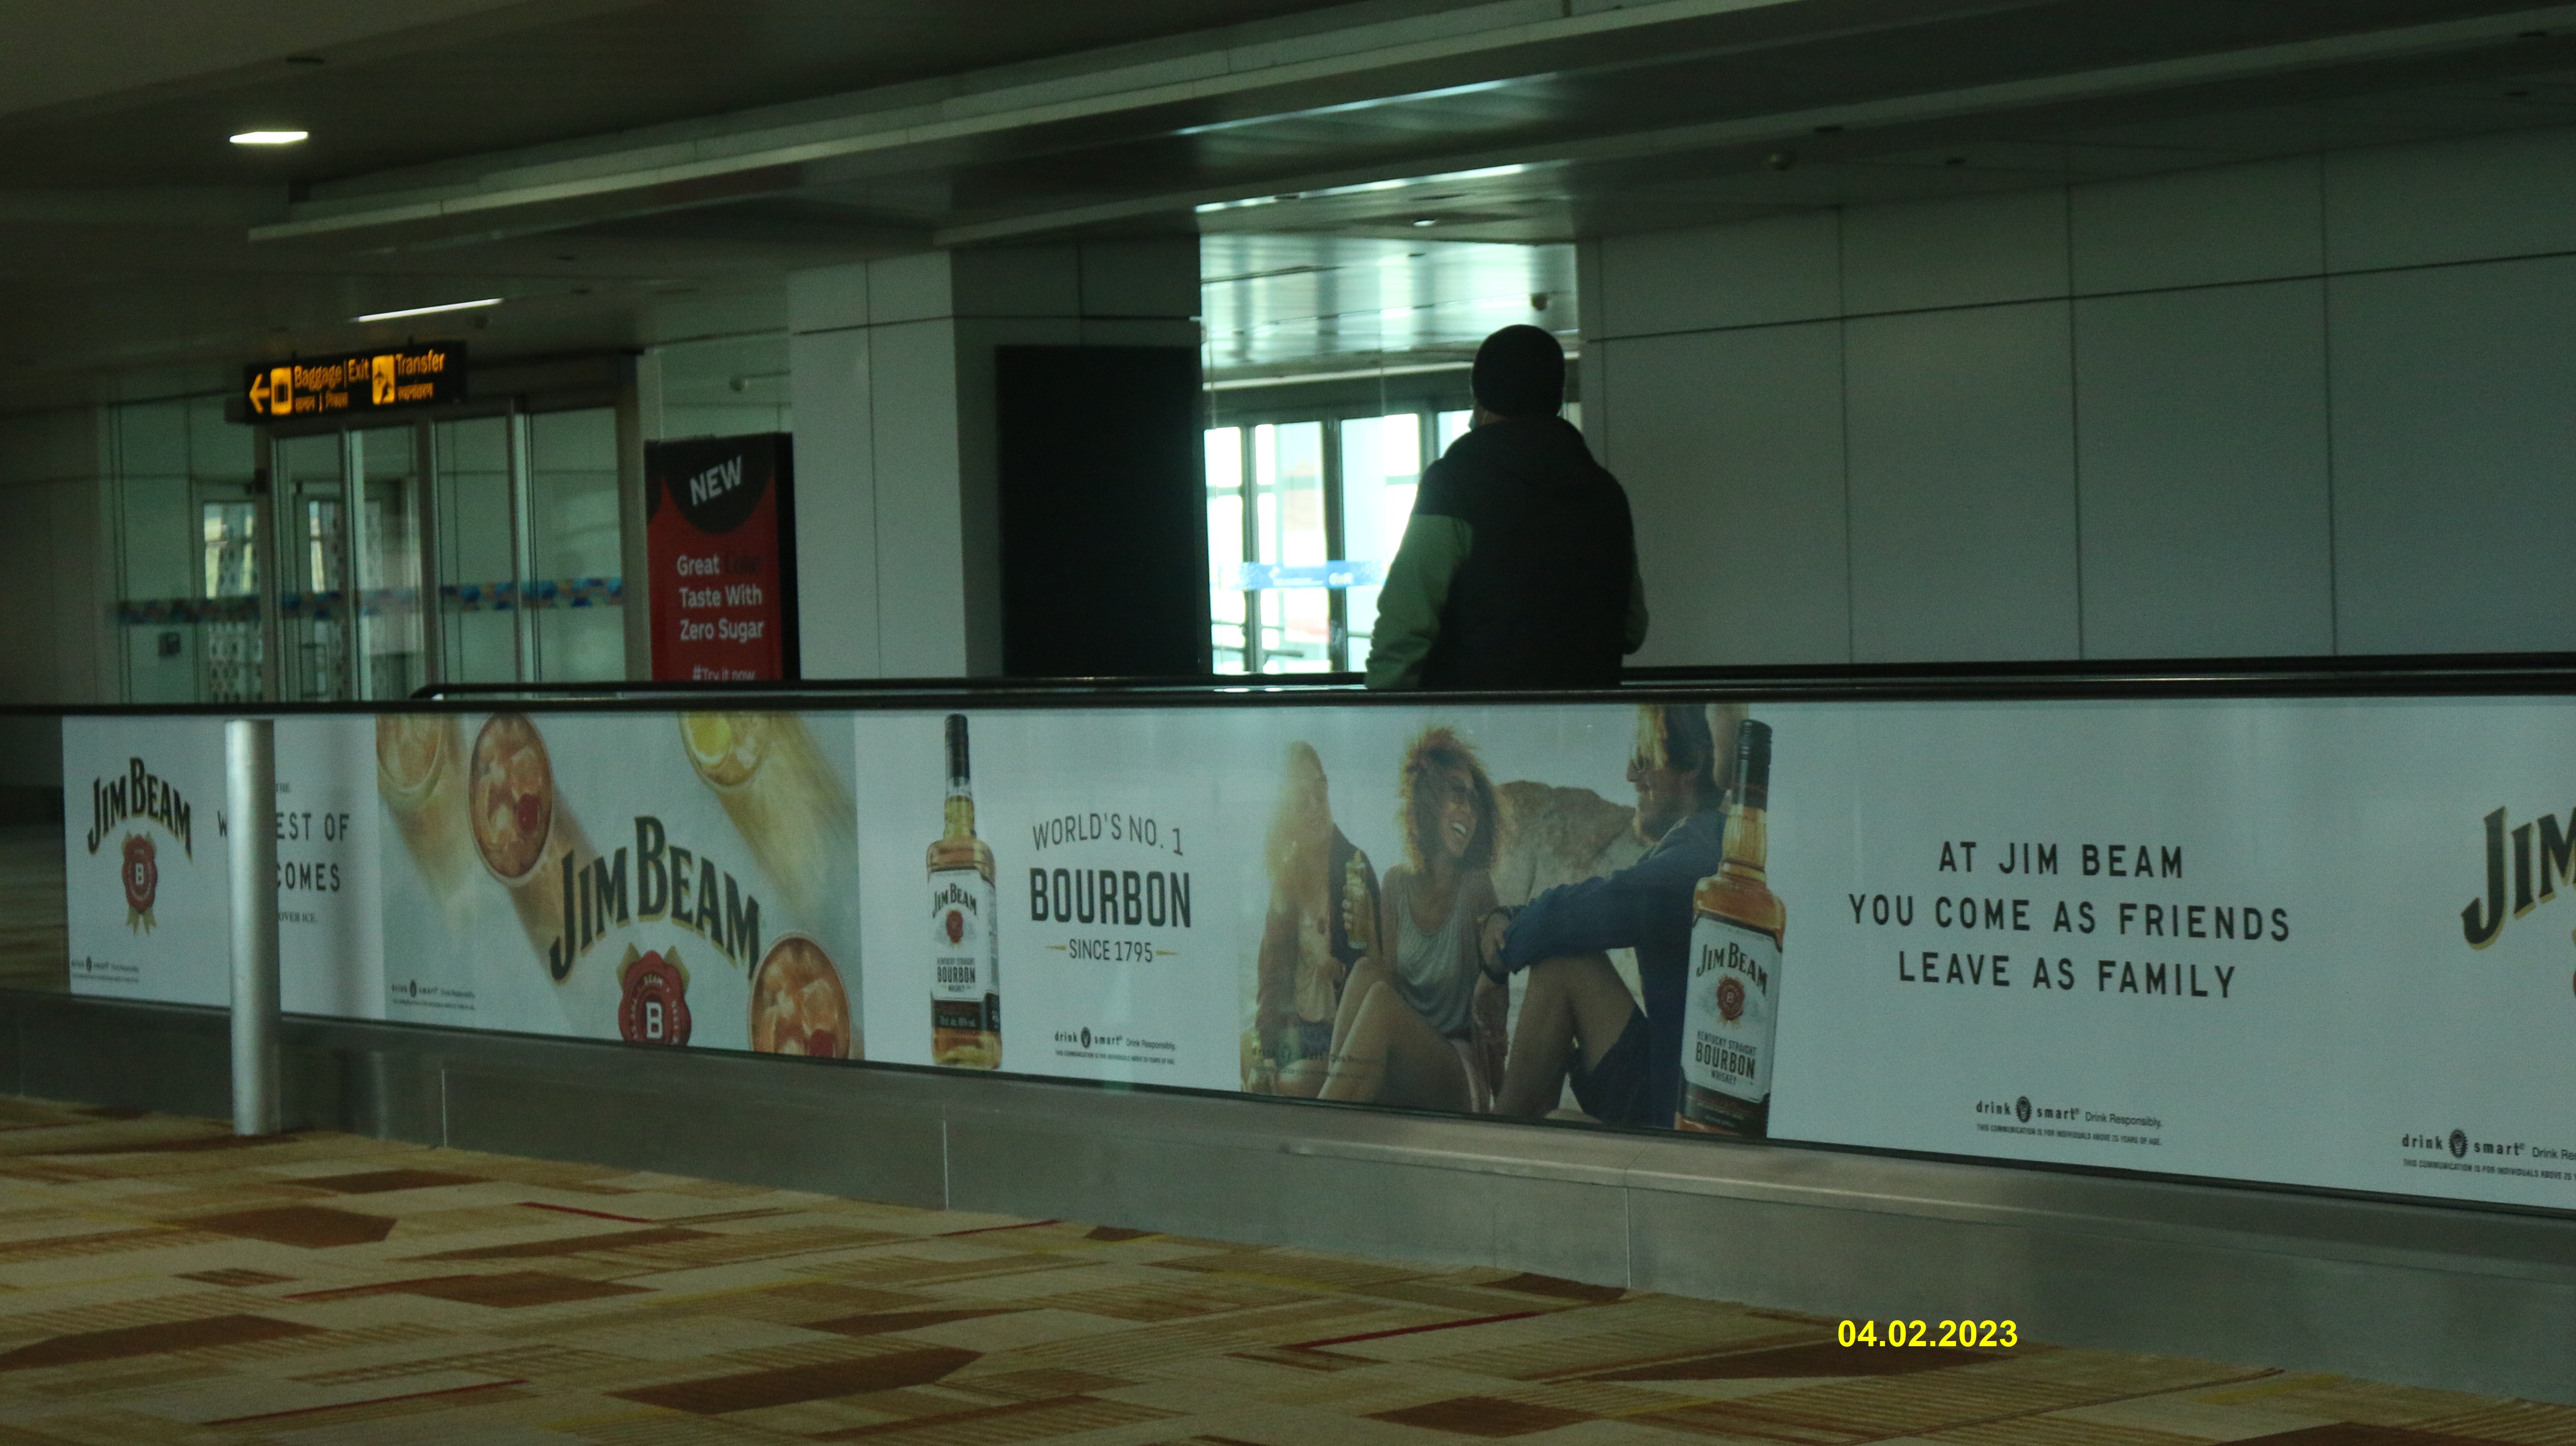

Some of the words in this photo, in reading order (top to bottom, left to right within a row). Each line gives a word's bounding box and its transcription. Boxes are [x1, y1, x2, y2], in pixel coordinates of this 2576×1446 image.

[294, 364, 343, 391] Baggage
[348, 358, 370, 382] Exit
[395, 349, 446, 375] Transfer
[689, 455, 743, 507] NEW
[676, 553, 720, 577] Great
[679, 586, 722, 609] Taste
[724, 583, 763, 607] With
[679, 618, 714, 642] Zero
[718, 617, 764, 644] Sugar
[87, 775, 127, 855] JIM
[129, 756, 192, 860] BEAM
[324, 812, 349, 841] OF
[1033, 813, 1121, 851] WORLD'S
[1129, 815, 1163, 848] NO.
[1173, 828, 1183, 856] 1
[1939, 841, 1976, 872] AT
[1998, 842, 2058, 875] JIM
[2082, 844, 2182, 878] BEAM
[549, 845, 631, 985] JIM
[634, 816, 760, 981] BEAM
[1030, 867, 1191, 928] BOURBON
[1848, 893, 1913, 925] YOU
[1935, 896, 2030, 931] COME
[2053, 901, 2095, 934] AS
[2120, 903, 2289, 941] FRIENDS
[1069, 939, 1110, 961] SINCE
[1115, 941, 1152, 963] 1795
[1696, 944, 1724, 977] JIM
[1728, 942, 1767, 996] BEAM
[937, 967, 975, 983] BOURBON
[1899, 951, 2010, 987] LEAVE
[2032, 957, 2074, 990] AS
[2098, 960, 2234, 998] FAMILY
[646, 1001, 663, 1039] B
[1696, 1041, 1755, 1079] BOURBON
[1977, 1100, 2010, 1115] drink
[2402, 1133, 2442, 1149] drink
[2533, 1147, 2557, 1158] Drink
